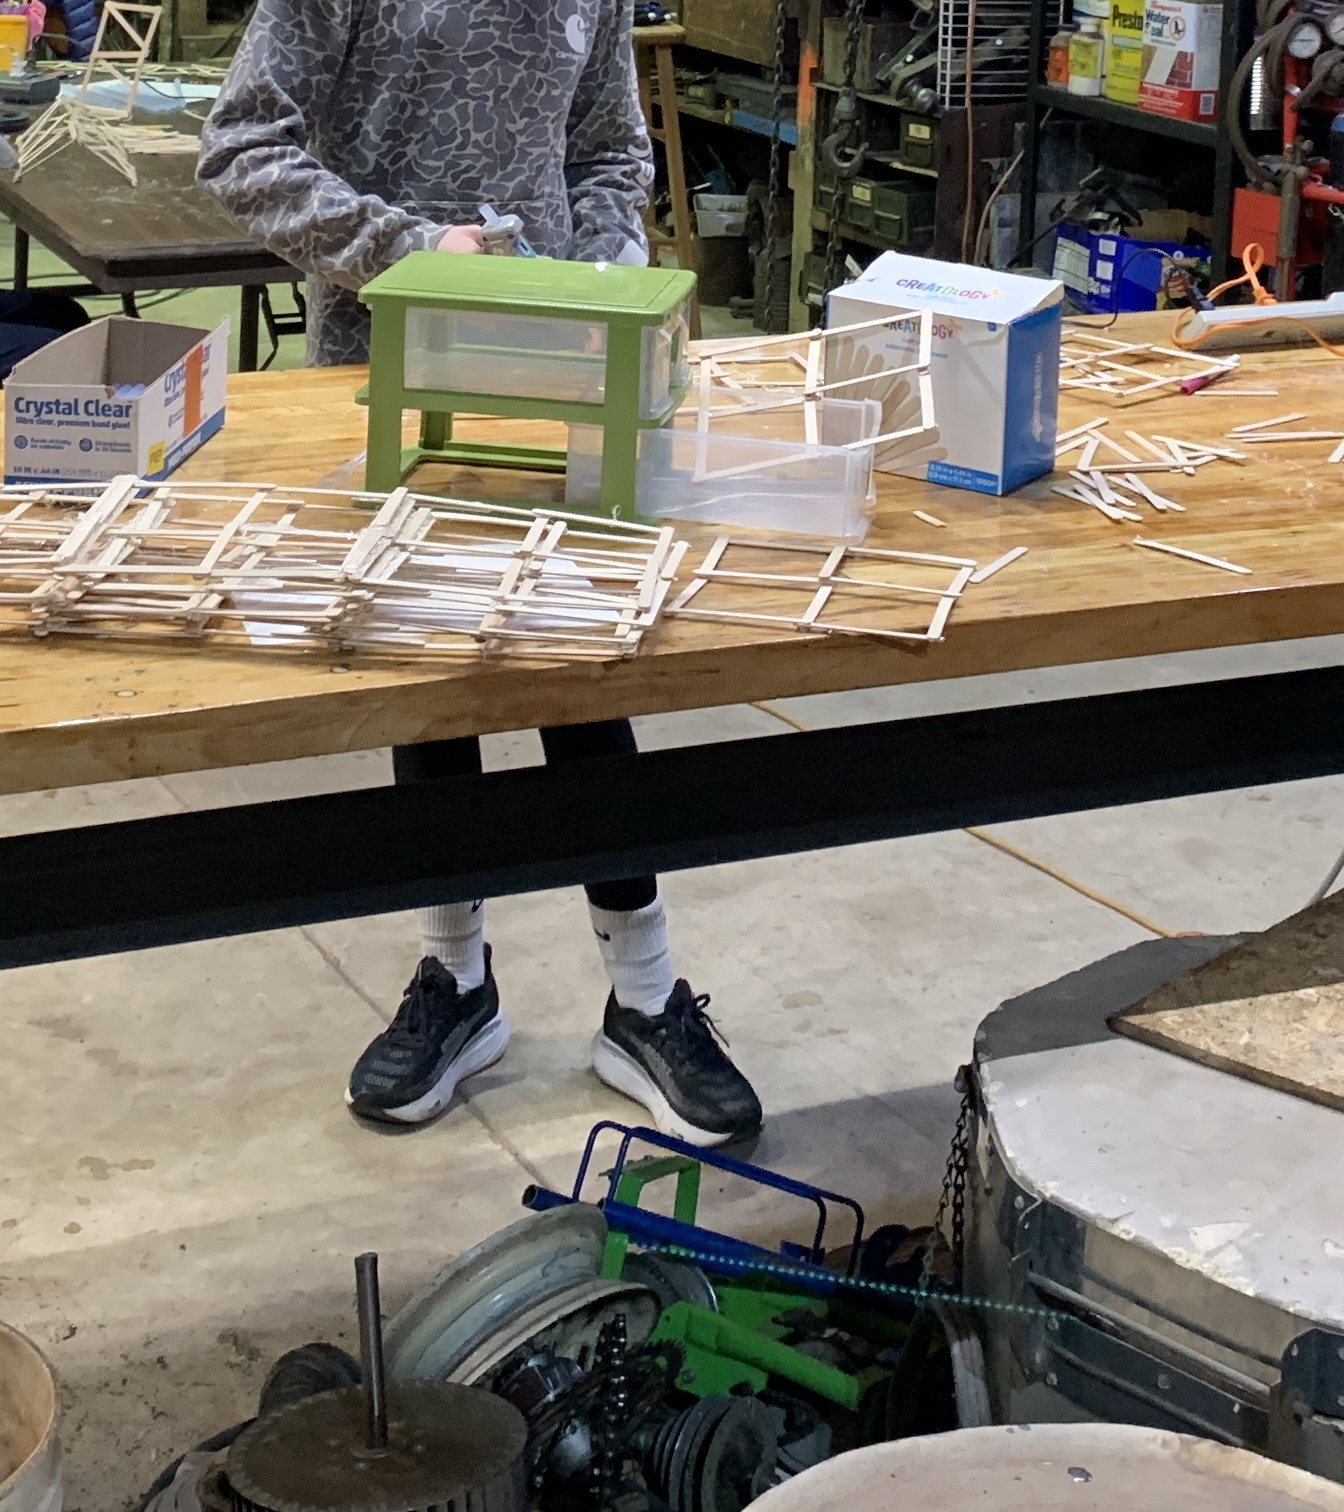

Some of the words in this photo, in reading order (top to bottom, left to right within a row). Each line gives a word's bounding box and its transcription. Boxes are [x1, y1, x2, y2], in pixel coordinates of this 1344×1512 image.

[1112, 4, 1144, 31] Presto
[1145, 9, 1170, 25] Water
[896, 278, 993, 300] CREATOLOGY
[883, 319, 954, 339] REATOGY
[14, 397, 80, 418] Crystal
[83, 399, 133, 418] Clear
